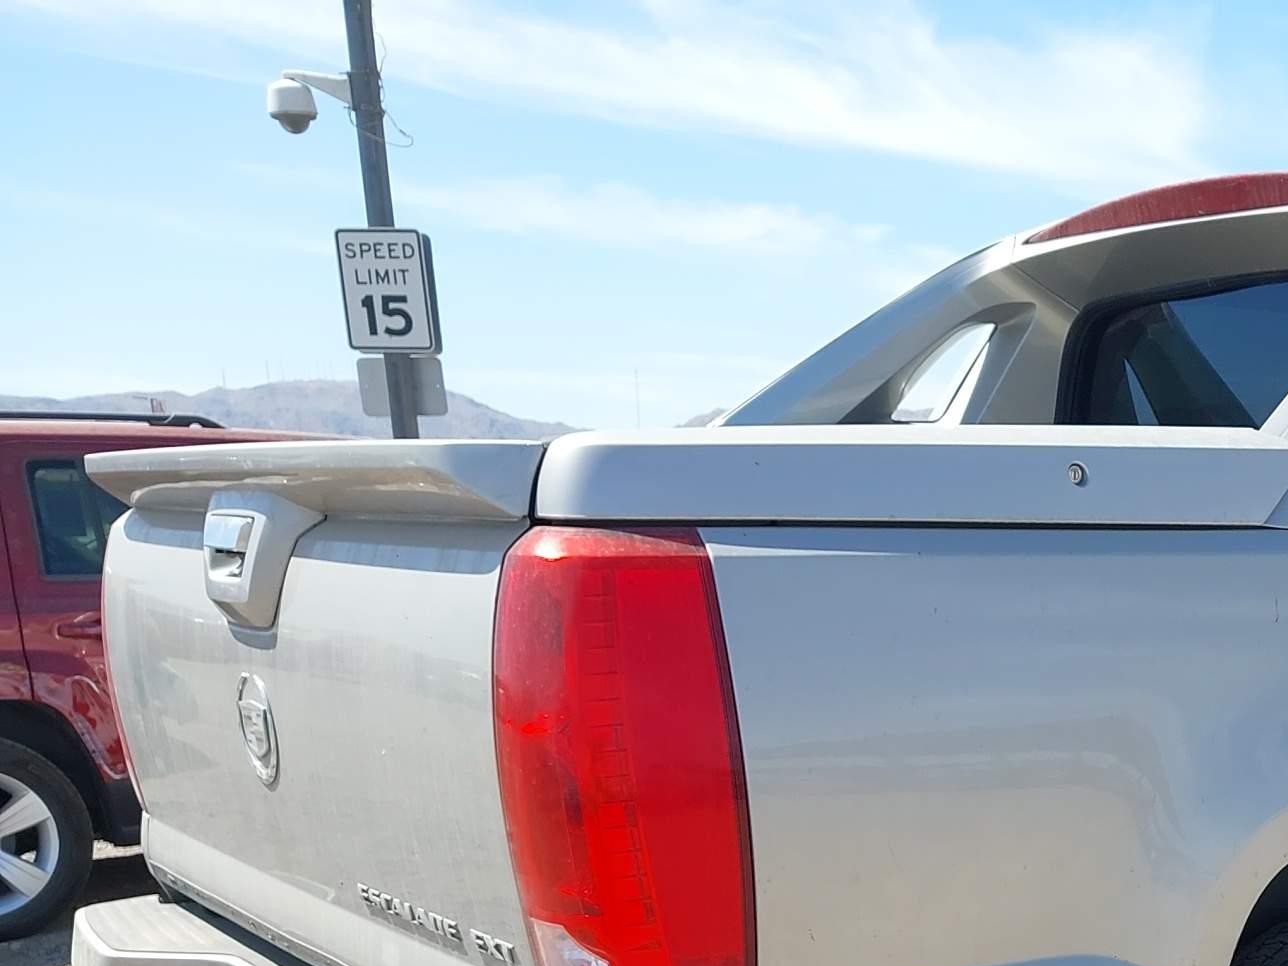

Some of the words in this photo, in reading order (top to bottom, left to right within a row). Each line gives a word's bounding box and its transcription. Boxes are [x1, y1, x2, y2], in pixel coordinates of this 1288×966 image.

[344, 242, 415, 259] SPEED
[354, 268, 409, 285] LIMIT
[361, 294, 413, 336] 15
[357, 883, 463, 943] ESCALADE
[470, 928, 516, 964] EXT
